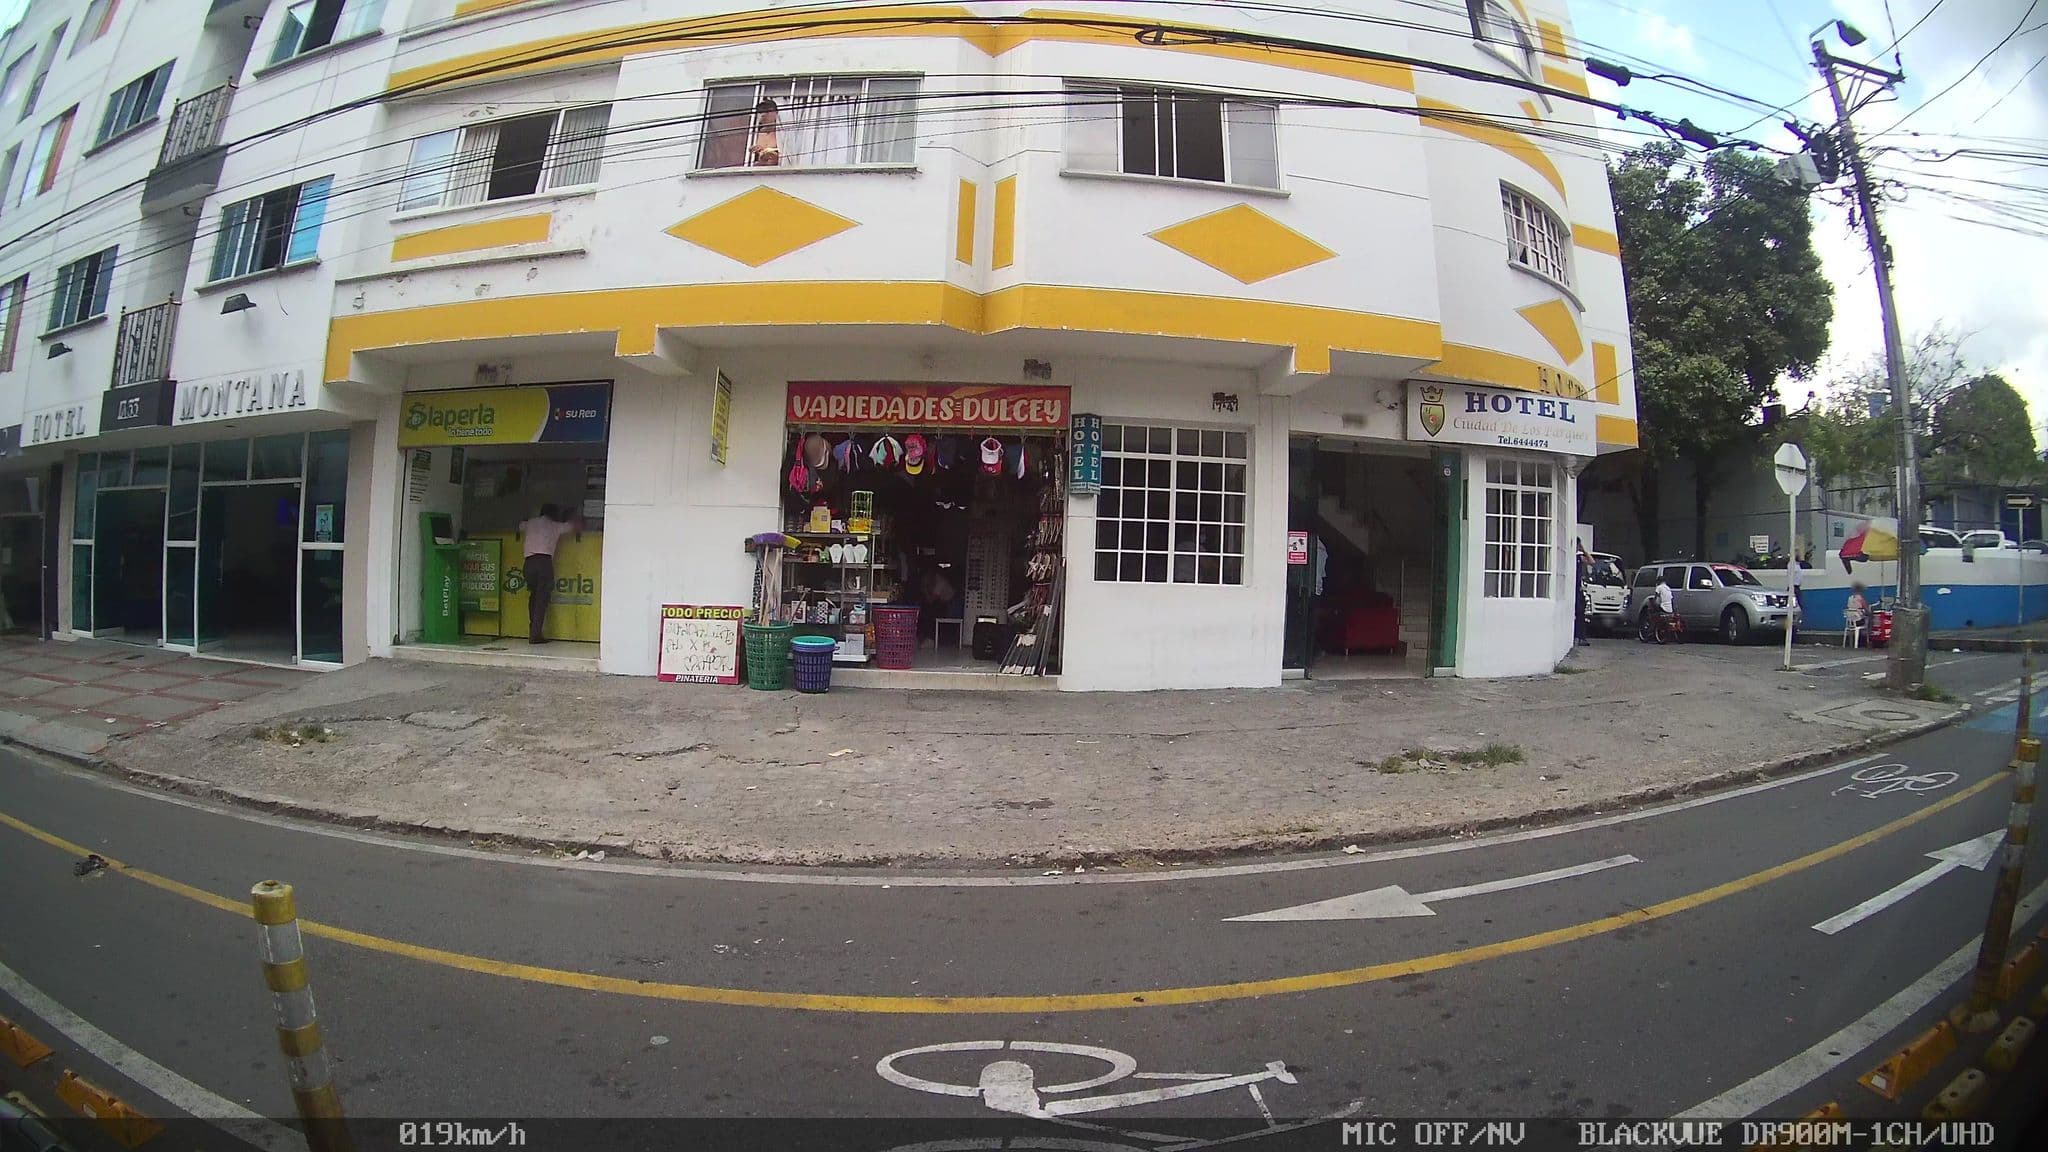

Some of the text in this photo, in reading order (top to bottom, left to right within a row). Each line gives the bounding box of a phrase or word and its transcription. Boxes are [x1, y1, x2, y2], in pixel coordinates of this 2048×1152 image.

[180, 369, 305, 421] MONTANA
[792, 394, 1061, 423] VARIEDADES DULCEY
[1465, 391, 1575, 424] HOTEL
[32, 405, 86, 443] HOTEL
[1453, 416, 1497, 433] Ciudad
[1073, 416, 1086, 480] HOTEL
[1090, 417, 1100, 481] HOTEL
[1497, 435, 1549, 449] Tel.6444474
[481, 563, 496, 572] SUS
[662, 607, 741, 619] TODO PRECIO
